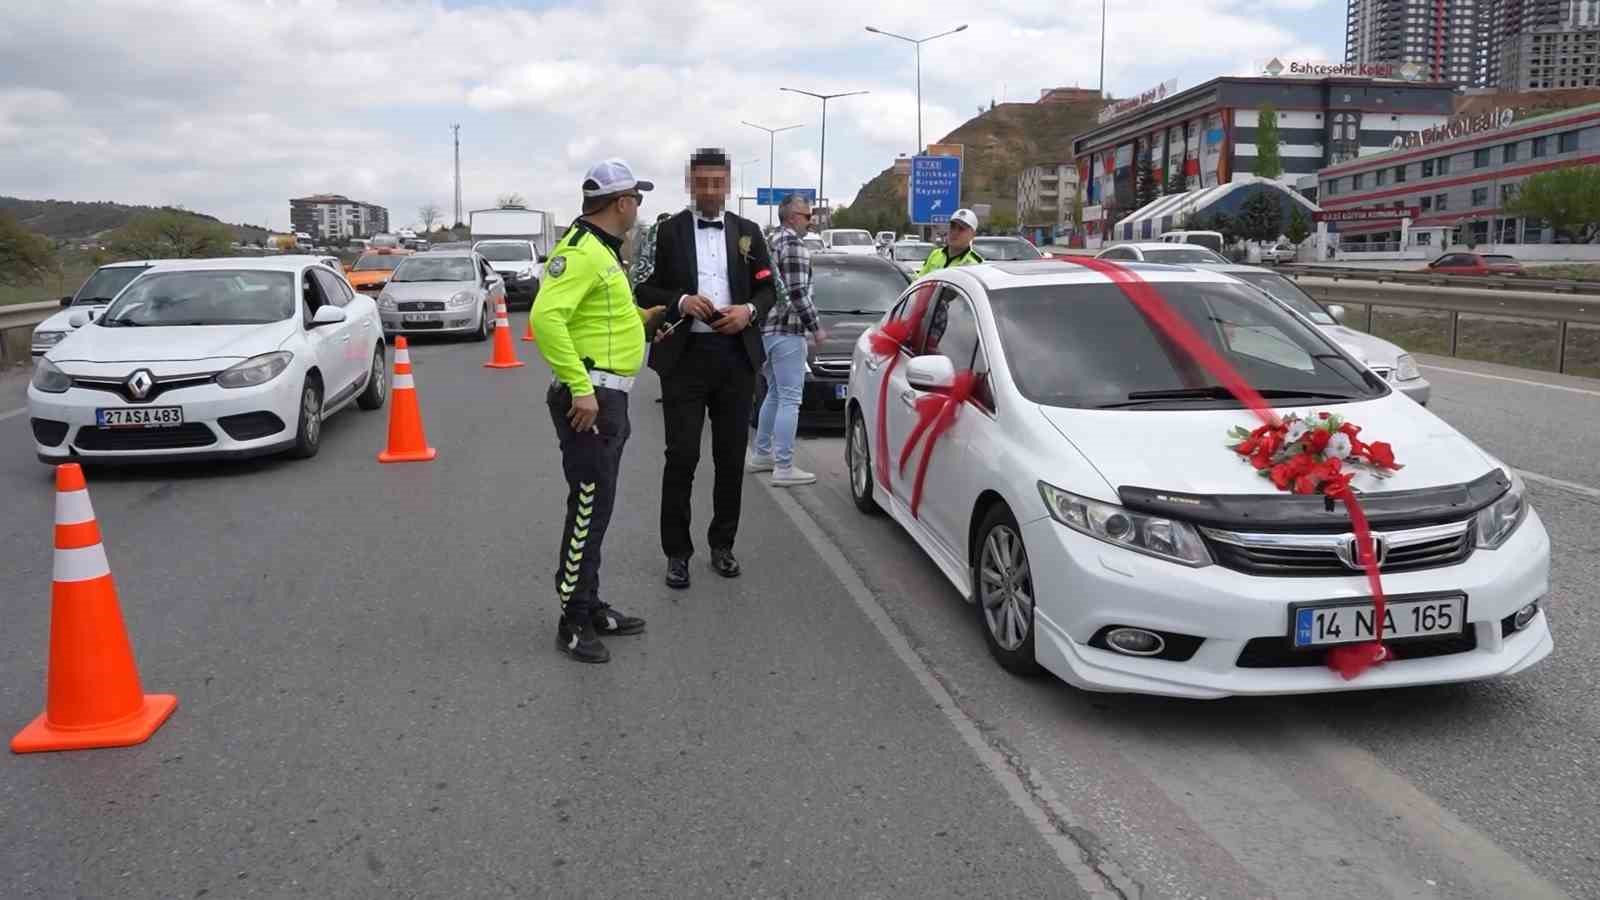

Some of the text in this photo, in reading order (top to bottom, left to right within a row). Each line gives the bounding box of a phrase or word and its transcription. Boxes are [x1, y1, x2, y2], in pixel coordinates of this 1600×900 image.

[105, 409, 180, 424] 27 ASA 483
[1315, 612, 1342, 640] 14
[1354, 607, 1397, 637] NA
[1411, 604, 1453, 632] 165
